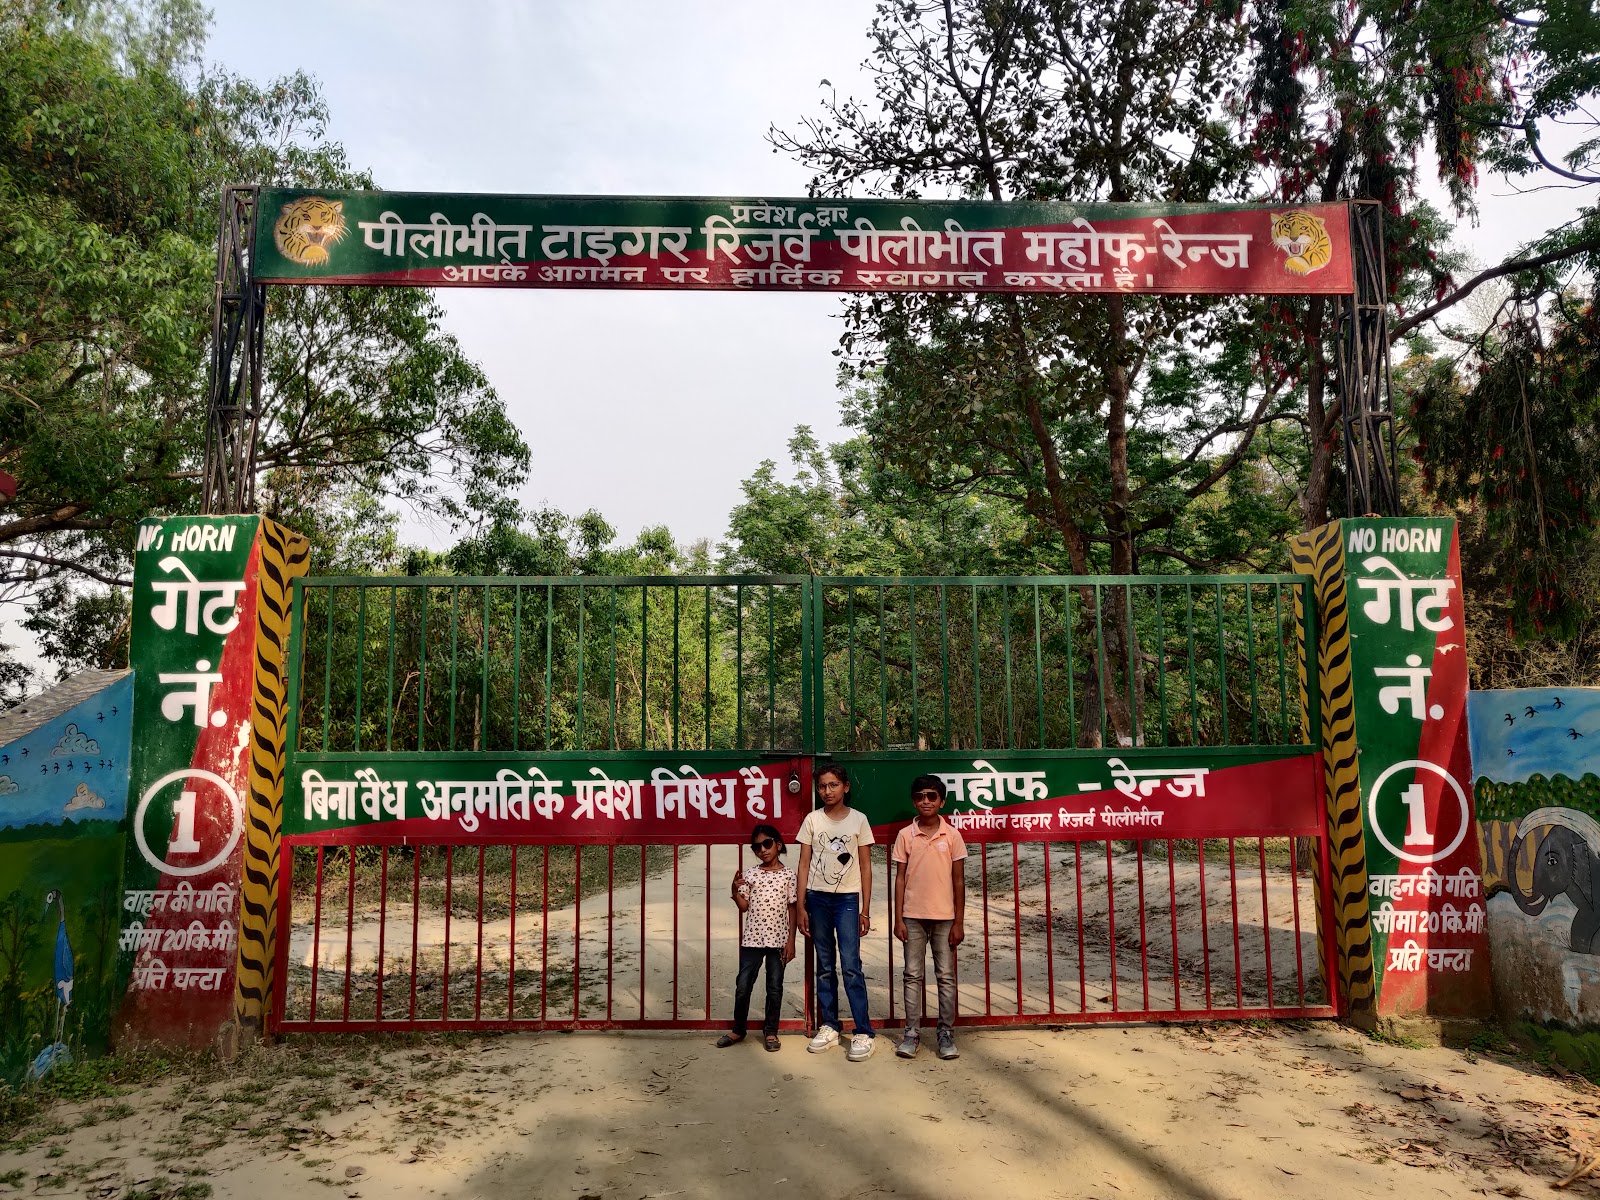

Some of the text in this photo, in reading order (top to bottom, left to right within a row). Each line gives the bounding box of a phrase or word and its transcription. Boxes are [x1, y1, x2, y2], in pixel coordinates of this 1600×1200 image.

[730, 199, 849, 227] प्रवेश द्वार
[357, 211, 533, 260] पीलीभीत
[541, 225, 692, 266] टाइगर
[700, 213, 820, 265] रिजर्व
[833, 216, 1006, 267] पीलीभीत
[442, 258, 529, 282] आपके
[537, 266, 647, 282] आगमन
[660, 267, 709, 284] पर
[729, 262, 843, 288] हार्दिक
[856, 270, 987, 288] स्वागत
[1003, 272, 1103, 291] करता
[171, 525, 237, 552] HORN
[1348, 527, 1442, 553] NO HORN
[150, 556, 247, 635] गेट
[1357, 556, 1457, 632] गेट
[158, 659, 227, 728] नं.
[1374, 654, 1444, 720] नं.
[301, 769, 358, 820] बिना
[354, 767, 408, 821] वैध
[571, 767, 644, 820] प्रवेश
[651, 764, 737, 819] निषेध
[1107, 757, 1209, 802] रेन्ज
[169, 791, 200, 853] 1
[948, 805, 1164, 831] पीलीभीत टाइगर रिजर्व पीलीभीत
[1401, 783, 1434, 845] 1
[123, 881, 237, 917] वाहन की गति
[1369, 867, 1481, 901] वाहन की गति
[1371, 901, 1419, 933] सीमा
[1419, 911, 1439, 933] 20
[119, 920, 165, 951] सीमा
[162, 929, 186, 951] 20
[1387, 939, 1474, 972] प्रति घन्टा
[128, 959, 227, 992] प्रति घन्टा
